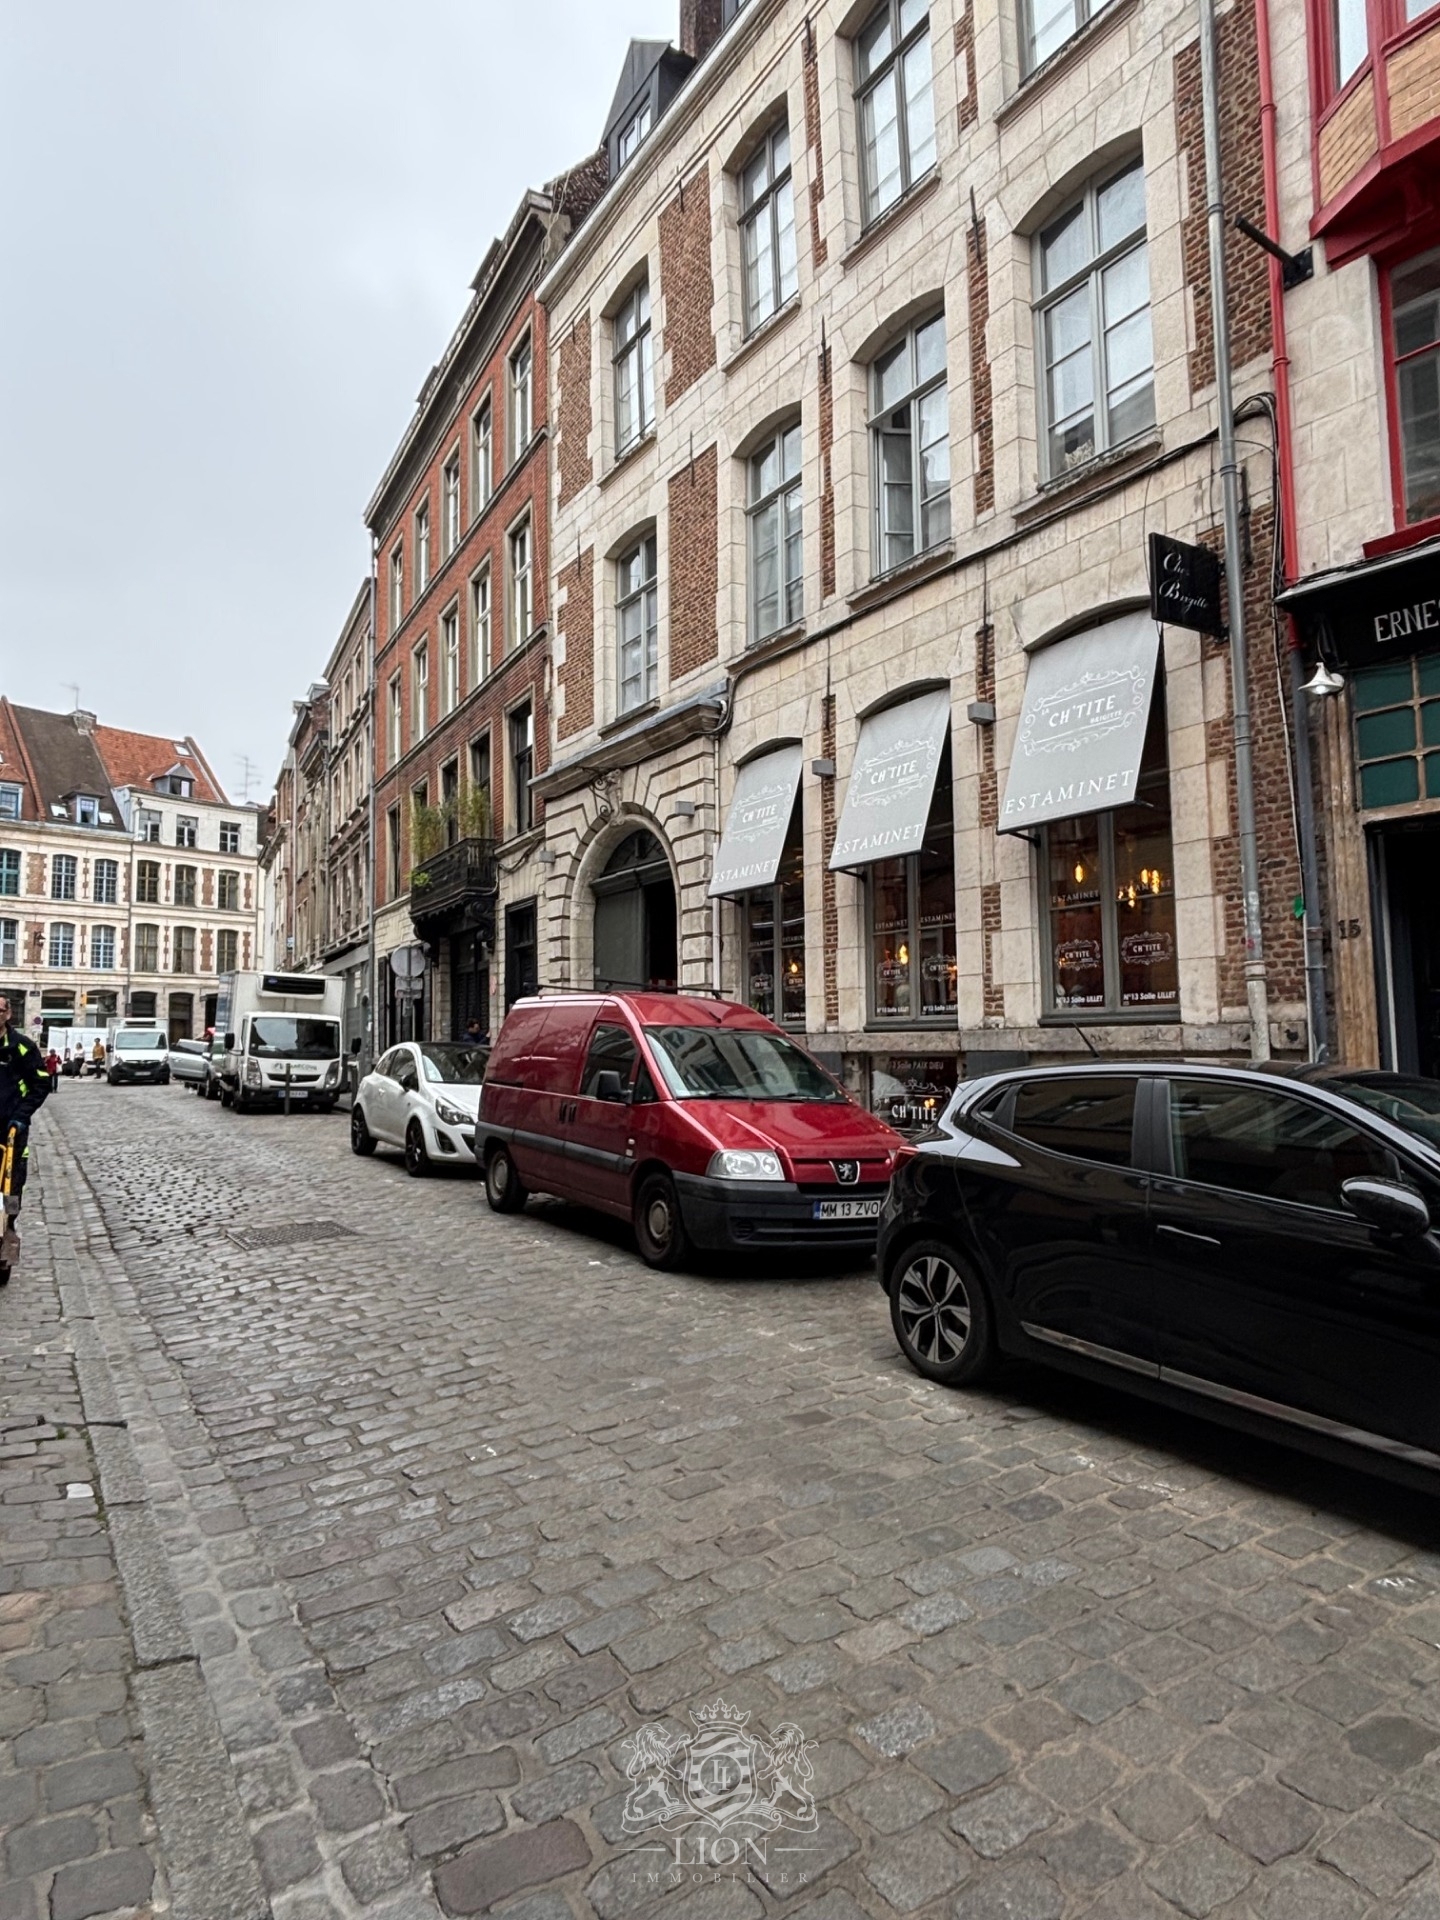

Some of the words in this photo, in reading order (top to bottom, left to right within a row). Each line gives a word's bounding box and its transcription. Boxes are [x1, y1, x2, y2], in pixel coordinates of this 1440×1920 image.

[1374, 599, 1440, 642] ERNE
[1049, 695, 1116, 727] CH'TITE
[870, 759, 917, 785] CH'TITE
[1004, 769, 1134, 814] ESTAMINET
[835, 823, 923, 856] ESTAMINET
[714, 859, 778, 883] ESTAMINET
[1052, 890, 1099, 903] ESTAMINET
[1337, 918, 1361, 940] 15
[1140, 992, 1155, 1000] Salle
[1157, 991, 1176, 999] LILLET
[891, 1104, 937, 1120] CH'TITE
[821, 1203, 837, 1217] MM
[841, 1203, 851, 1216] 13
[855, 1202, 879, 1216] ZVO
